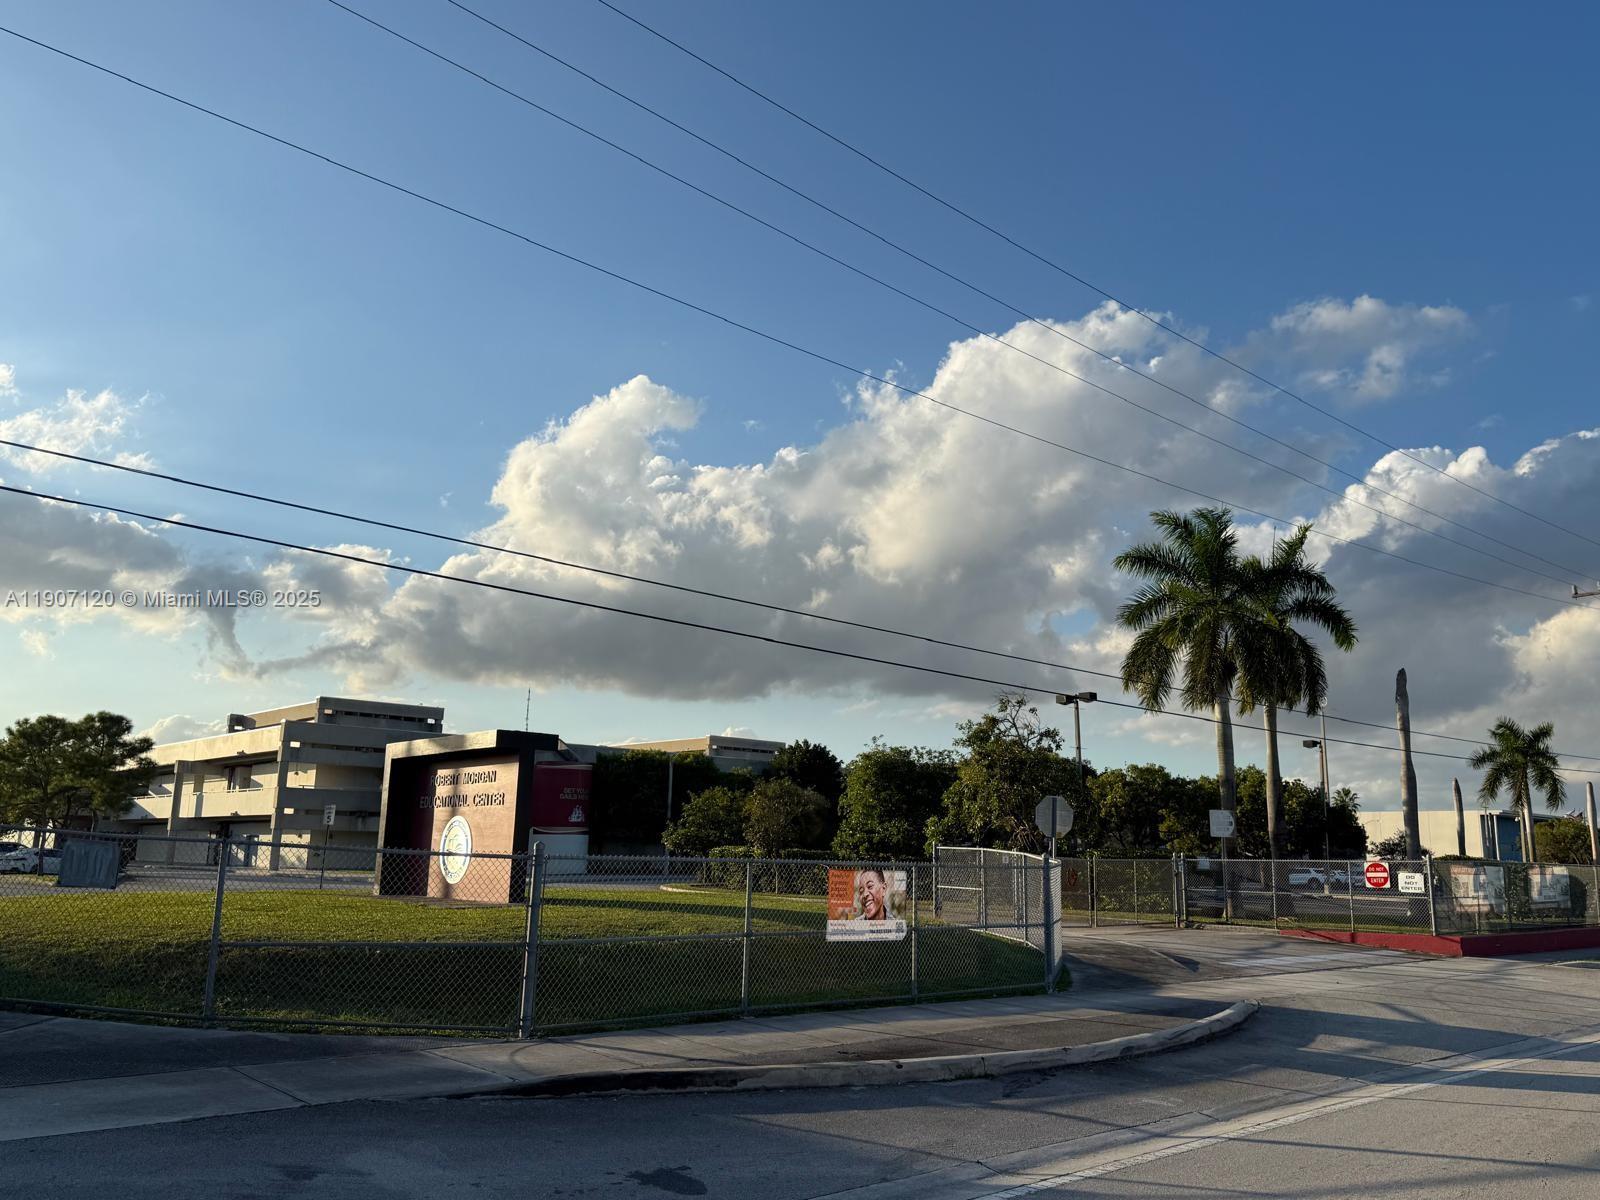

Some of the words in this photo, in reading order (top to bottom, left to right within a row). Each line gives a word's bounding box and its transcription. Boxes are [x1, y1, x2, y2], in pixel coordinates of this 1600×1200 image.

[431, 773, 460, 787] ROBERT
[462, 770, 497, 785] MORGAN
[420, 794, 469, 809] EDUCATIONAL
[473, 792, 505, 807] CENTER
